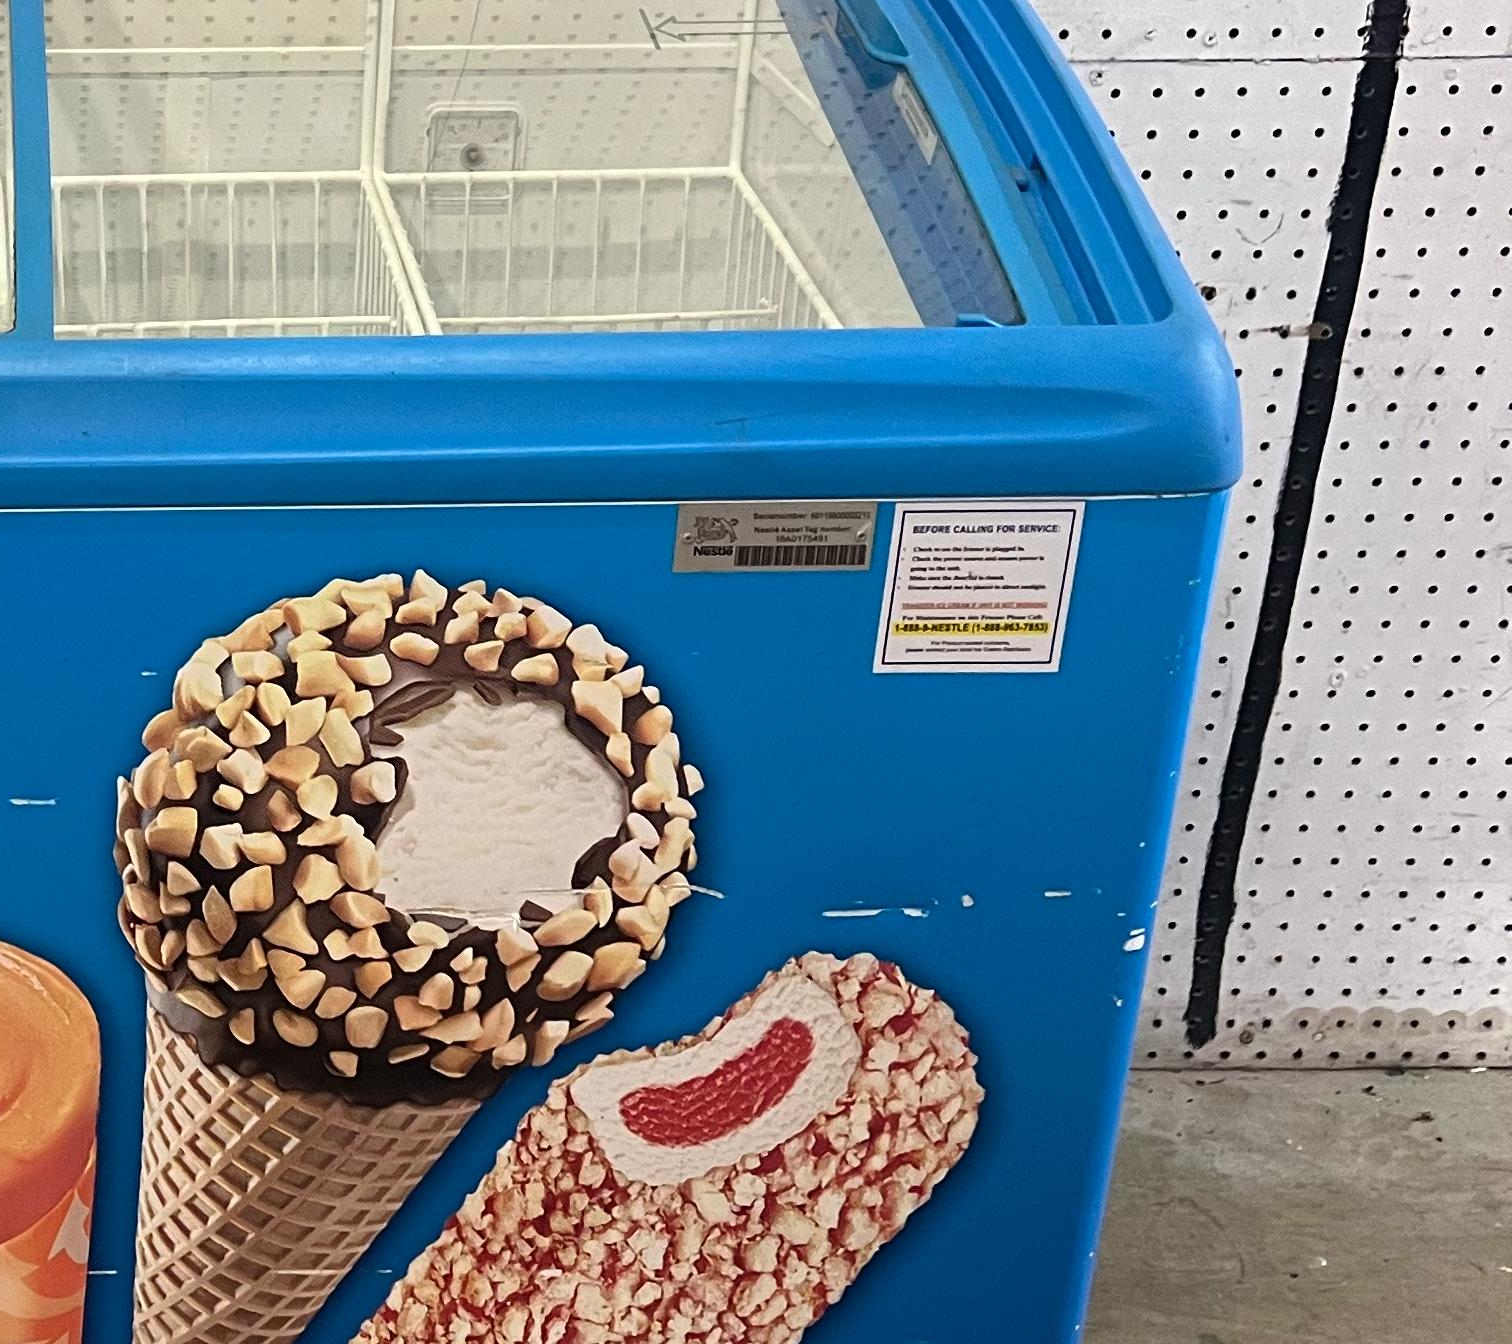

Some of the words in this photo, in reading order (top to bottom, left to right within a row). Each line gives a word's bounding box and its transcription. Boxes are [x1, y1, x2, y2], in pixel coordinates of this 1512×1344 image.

[913, 525, 950, 533] BEFORE
[953, 525, 993, 533] CALLING
[996, 524, 1015, 533] FOR
